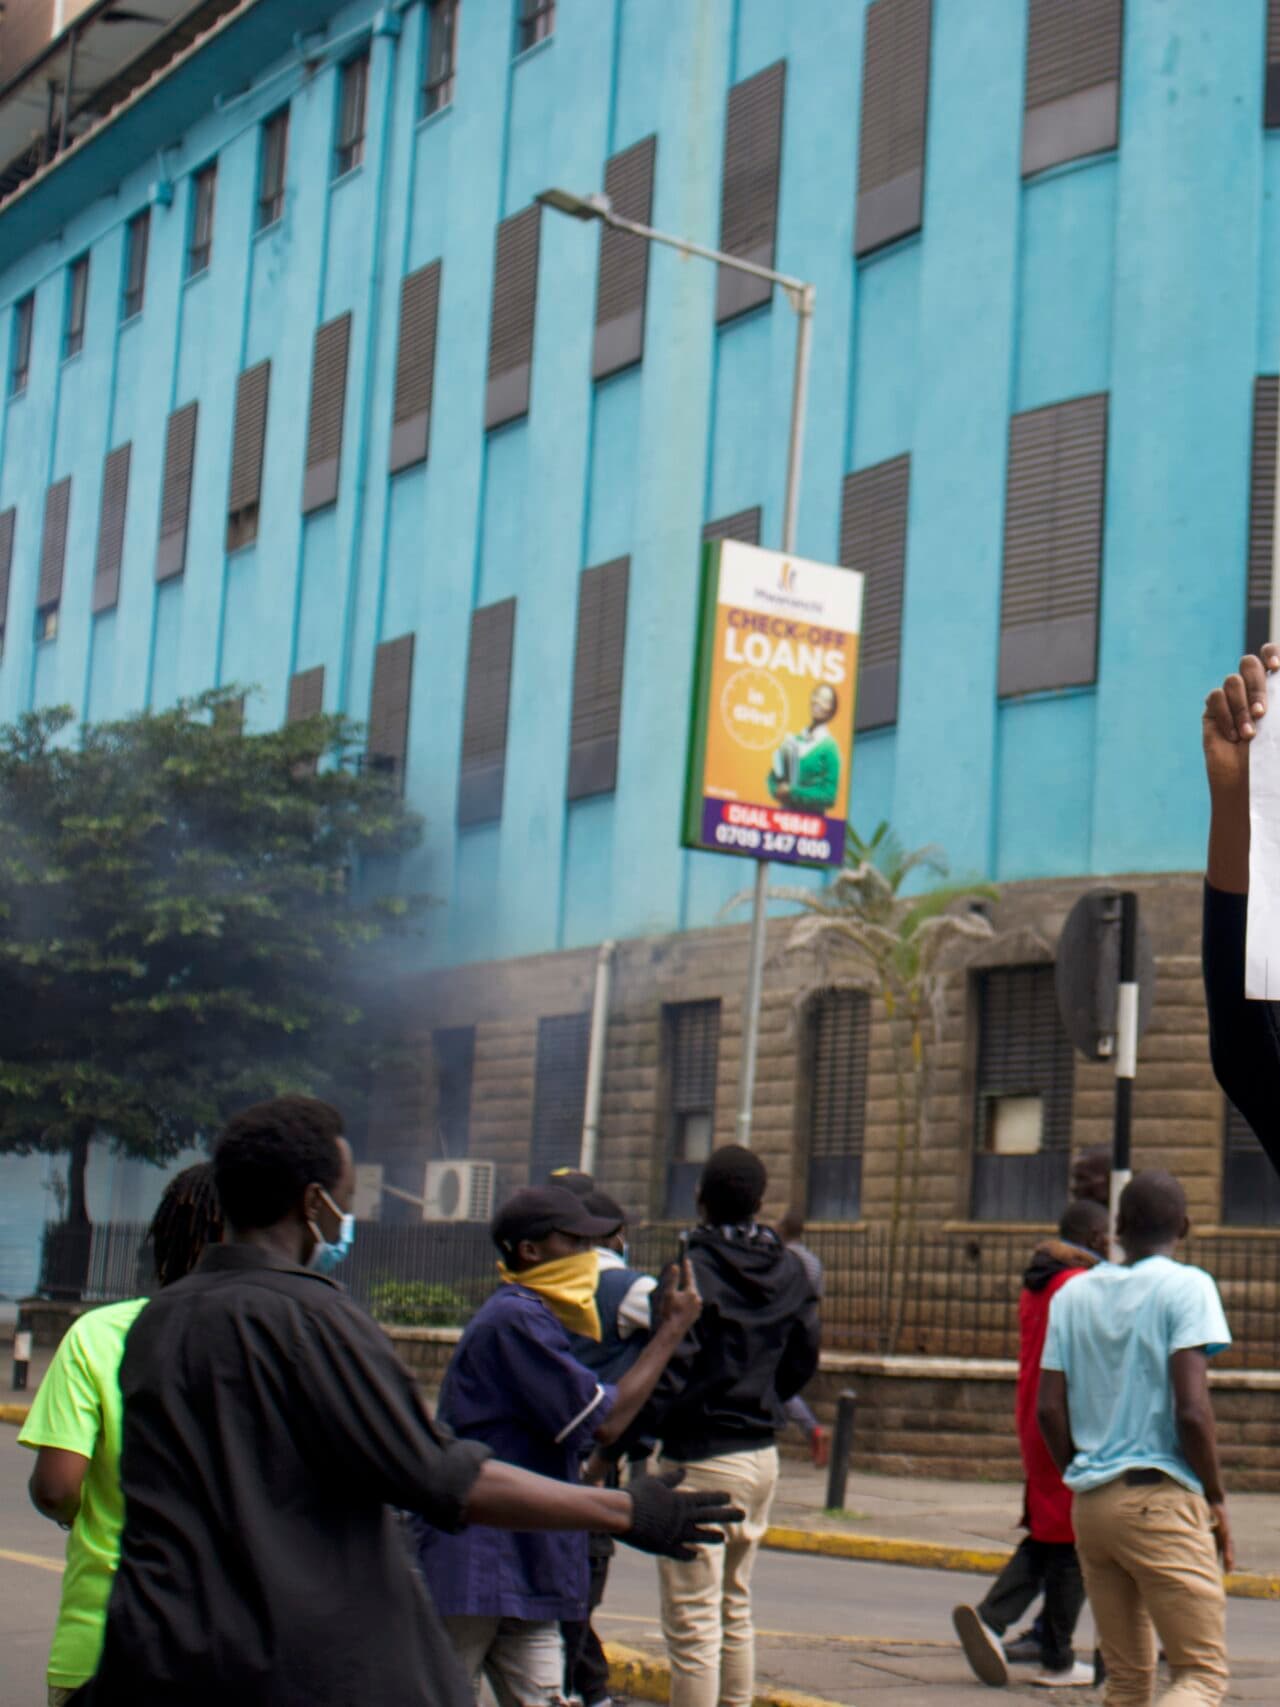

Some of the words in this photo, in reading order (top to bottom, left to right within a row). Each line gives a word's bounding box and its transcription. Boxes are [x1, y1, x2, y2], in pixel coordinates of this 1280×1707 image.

[727, 608, 846, 646] CHECK-OFF
[724, 627, 846, 684] LOANS
[728, 804, 770, 829] DIAL
[763, 831, 795, 853] 147
